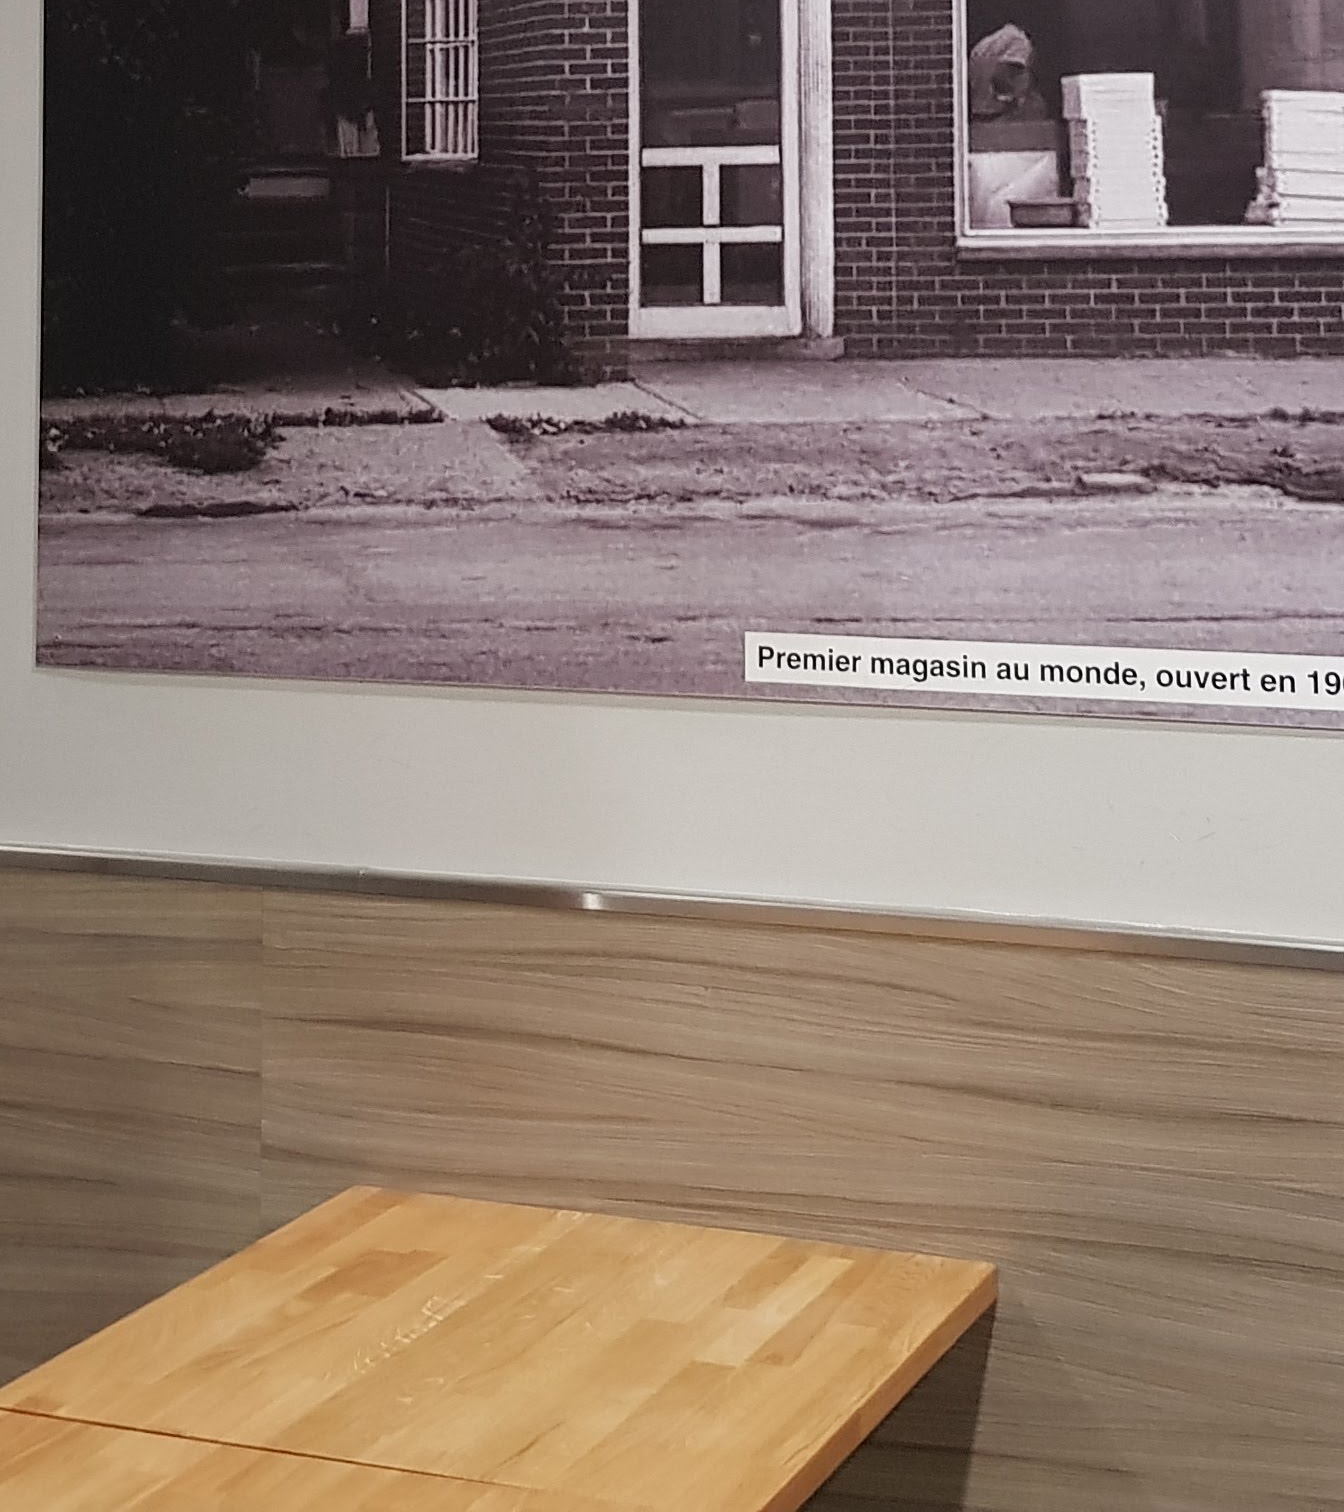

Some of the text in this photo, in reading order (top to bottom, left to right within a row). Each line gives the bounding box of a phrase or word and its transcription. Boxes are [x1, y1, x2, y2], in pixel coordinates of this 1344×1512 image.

[755, 645, 862, 672] Premier
[870, 654, 987, 683] magasin
[996, 662, 1029, 681] au
[1040, 661, 1147, 692] monde,
[1156, 668, 1251, 691] ouvert
[1260, 674, 1296, 693] en
